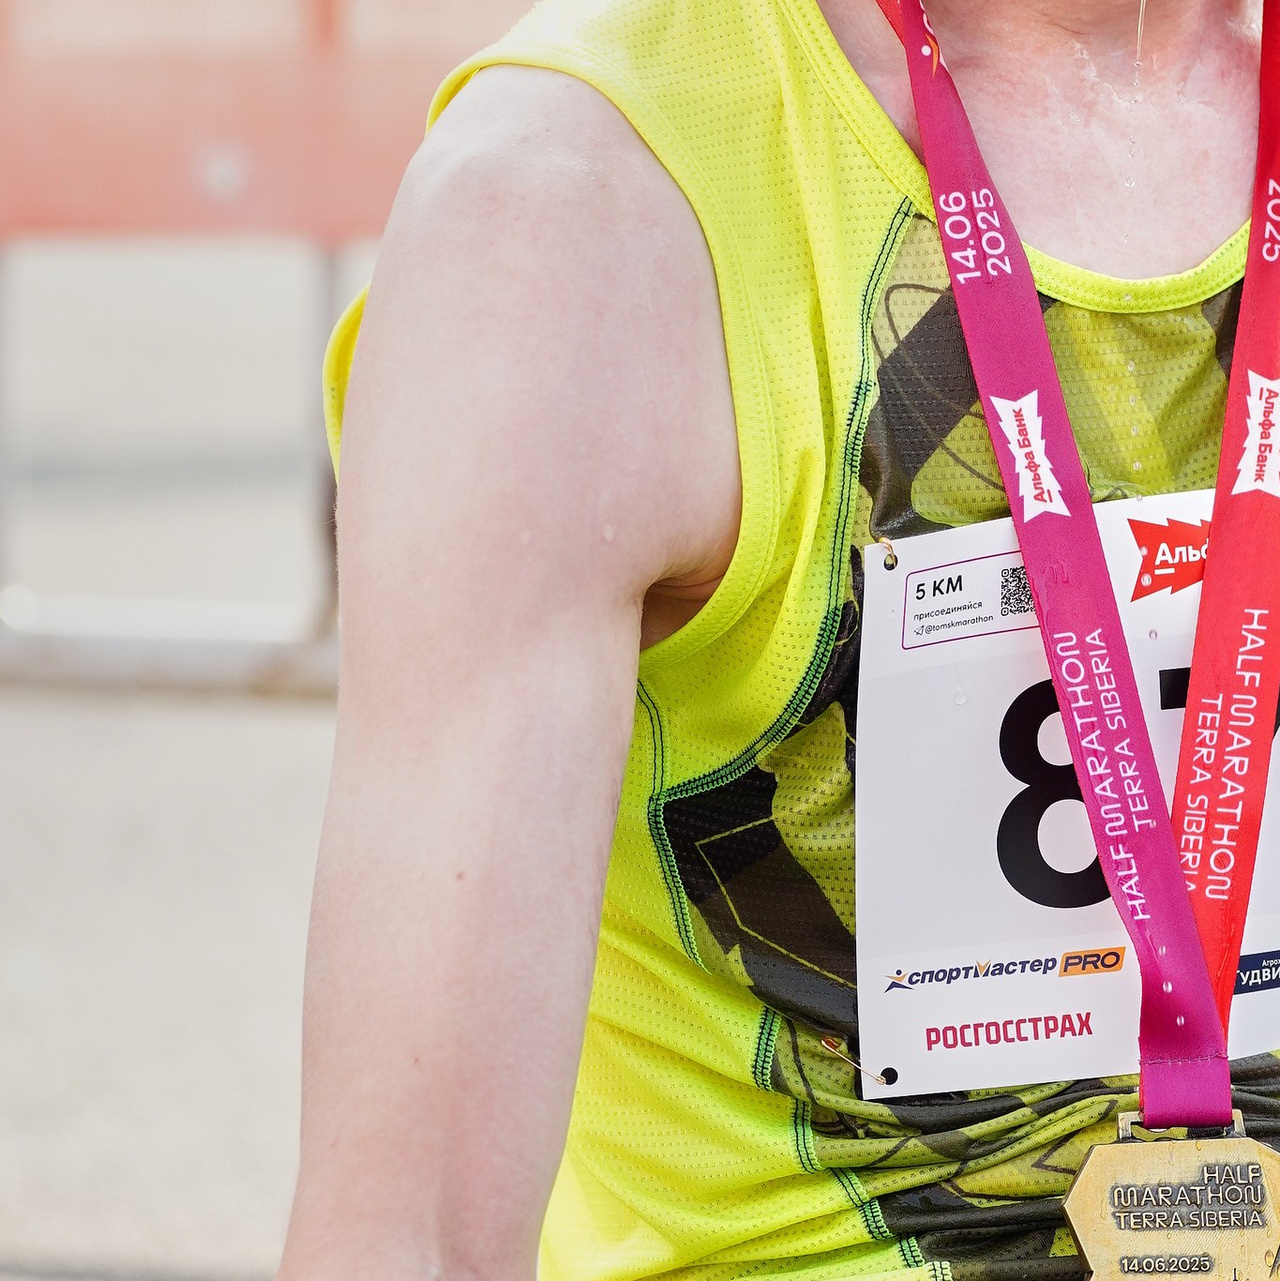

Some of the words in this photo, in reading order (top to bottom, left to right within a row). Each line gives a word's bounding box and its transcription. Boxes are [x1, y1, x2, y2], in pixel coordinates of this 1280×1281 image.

[939, 191, 982, 285] 14.06
[971, 188, 1012, 276] 2025
[1012, 407, 1032, 449] Банк
[1258, 388, 1279, 440] Альфа
[1025, 451, 1050, 503] Альфа
[1254, 443, 1273, 483] Банк
[914, 601, 983, 622] присоединяйся
[915, 583, 926, 600] 5
[924, 615, 994, 635] @tomskmarathon
[1236, 608, 1269, 688] HALF
[1085, 628, 1127, 731] SIBERIA
[1053, 632, 1128, 837] MARATHON
[1190, 693, 1223, 785] TERRA
[1114, 738, 1152, 832] TERRA
[1205, 694, 1258, 900] MARATHON
[1110, 844, 1151, 920] HALF
[1063, 950, 1121, 974] PRO
[926, 1012, 1093, 1051] РОСГОССТРАХ
[1113, 1185, 1262, 1208] MARATHON
[1203, 1164, 1261, 1184] HALF
[1116, 1211, 1187, 1230] TERRA
[1189, 1210, 1263, 1228] SIBERIA
[1122, 1257, 1210, 1273] 14.06.2025
